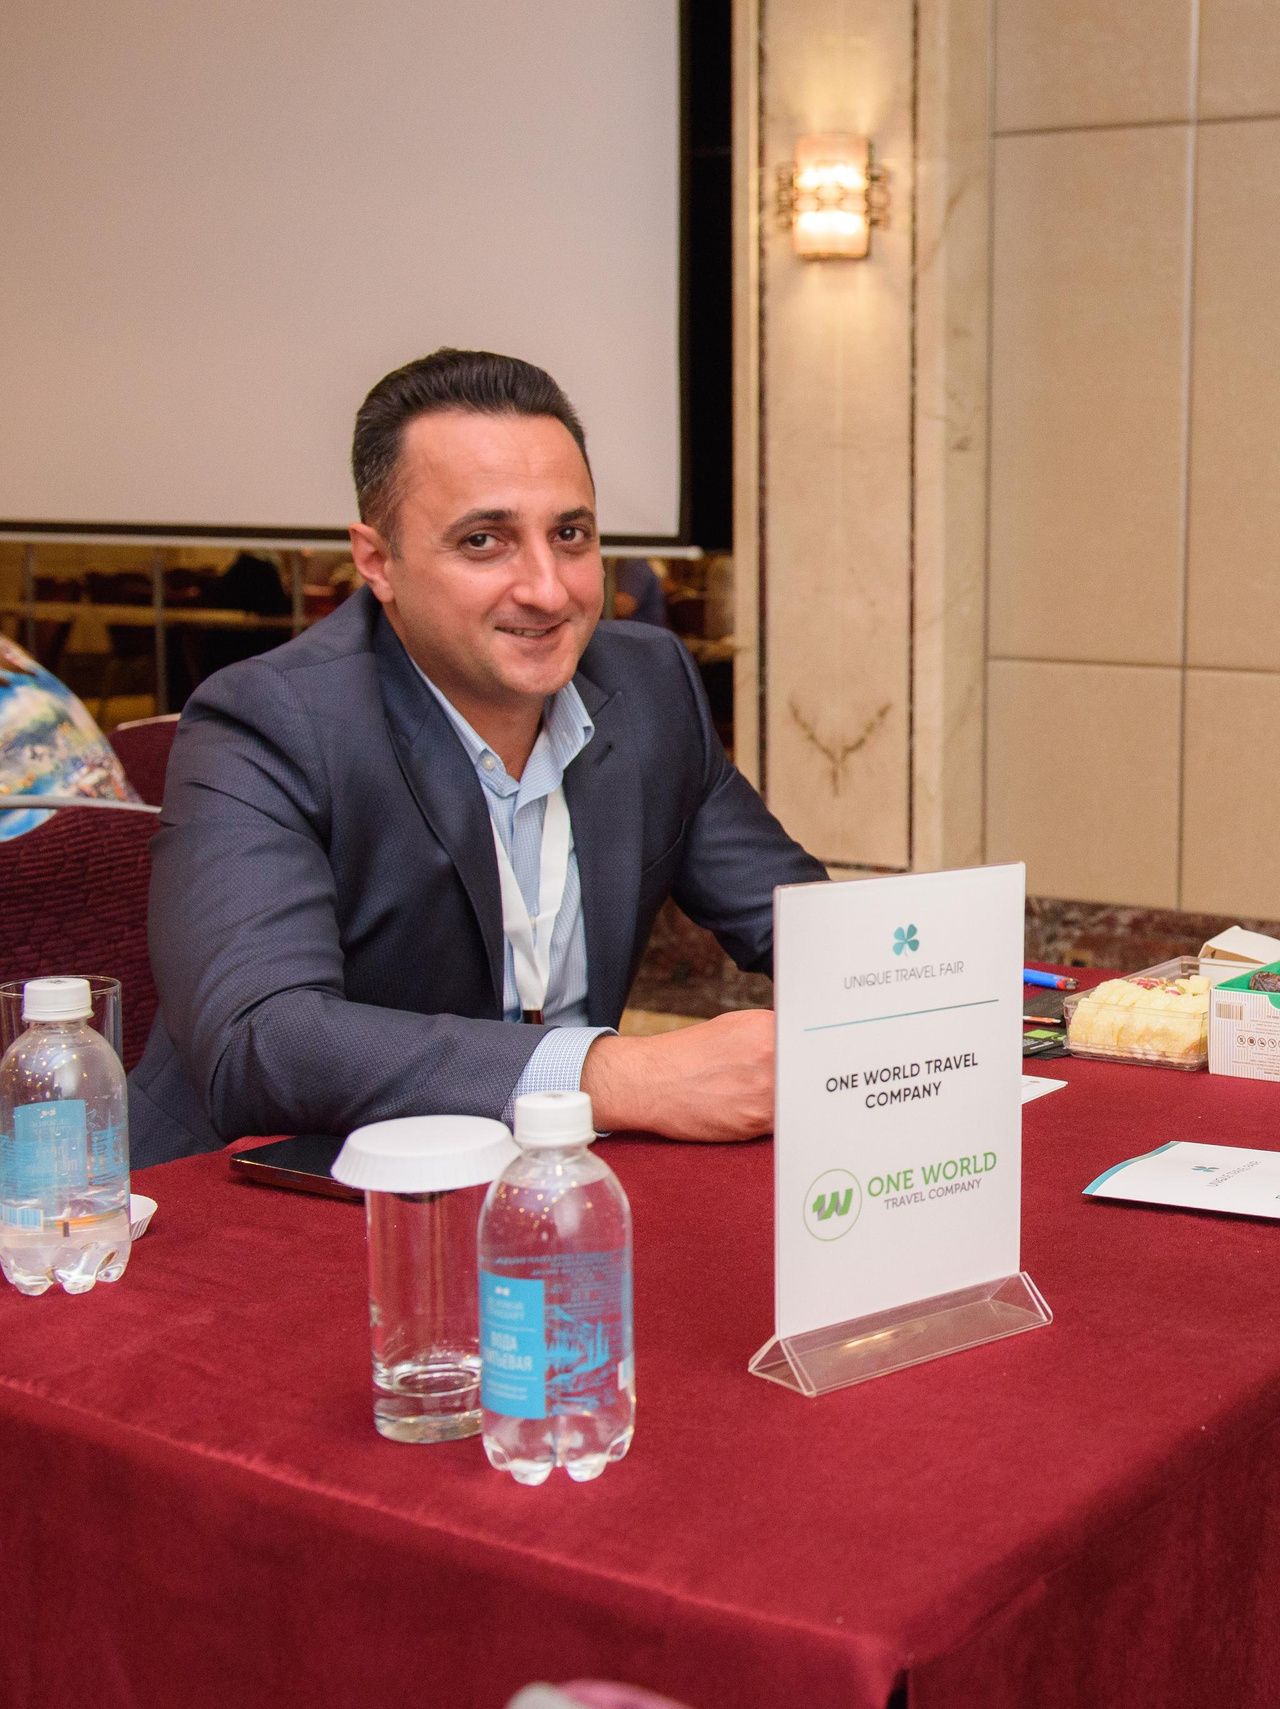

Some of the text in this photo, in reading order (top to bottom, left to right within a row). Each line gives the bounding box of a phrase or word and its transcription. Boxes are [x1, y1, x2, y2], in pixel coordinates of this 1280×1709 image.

[843, 960, 965, 990] UNIQUE TRAVEL FAIR
[825, 1052, 979, 1093] ONE WORLD TRAVEL
[864, 1080, 943, 1110] COMPANY
[867, 1151, 998, 1198] ONE WORLD
[883, 1177, 983, 1210] TRAVEL COMPANY
